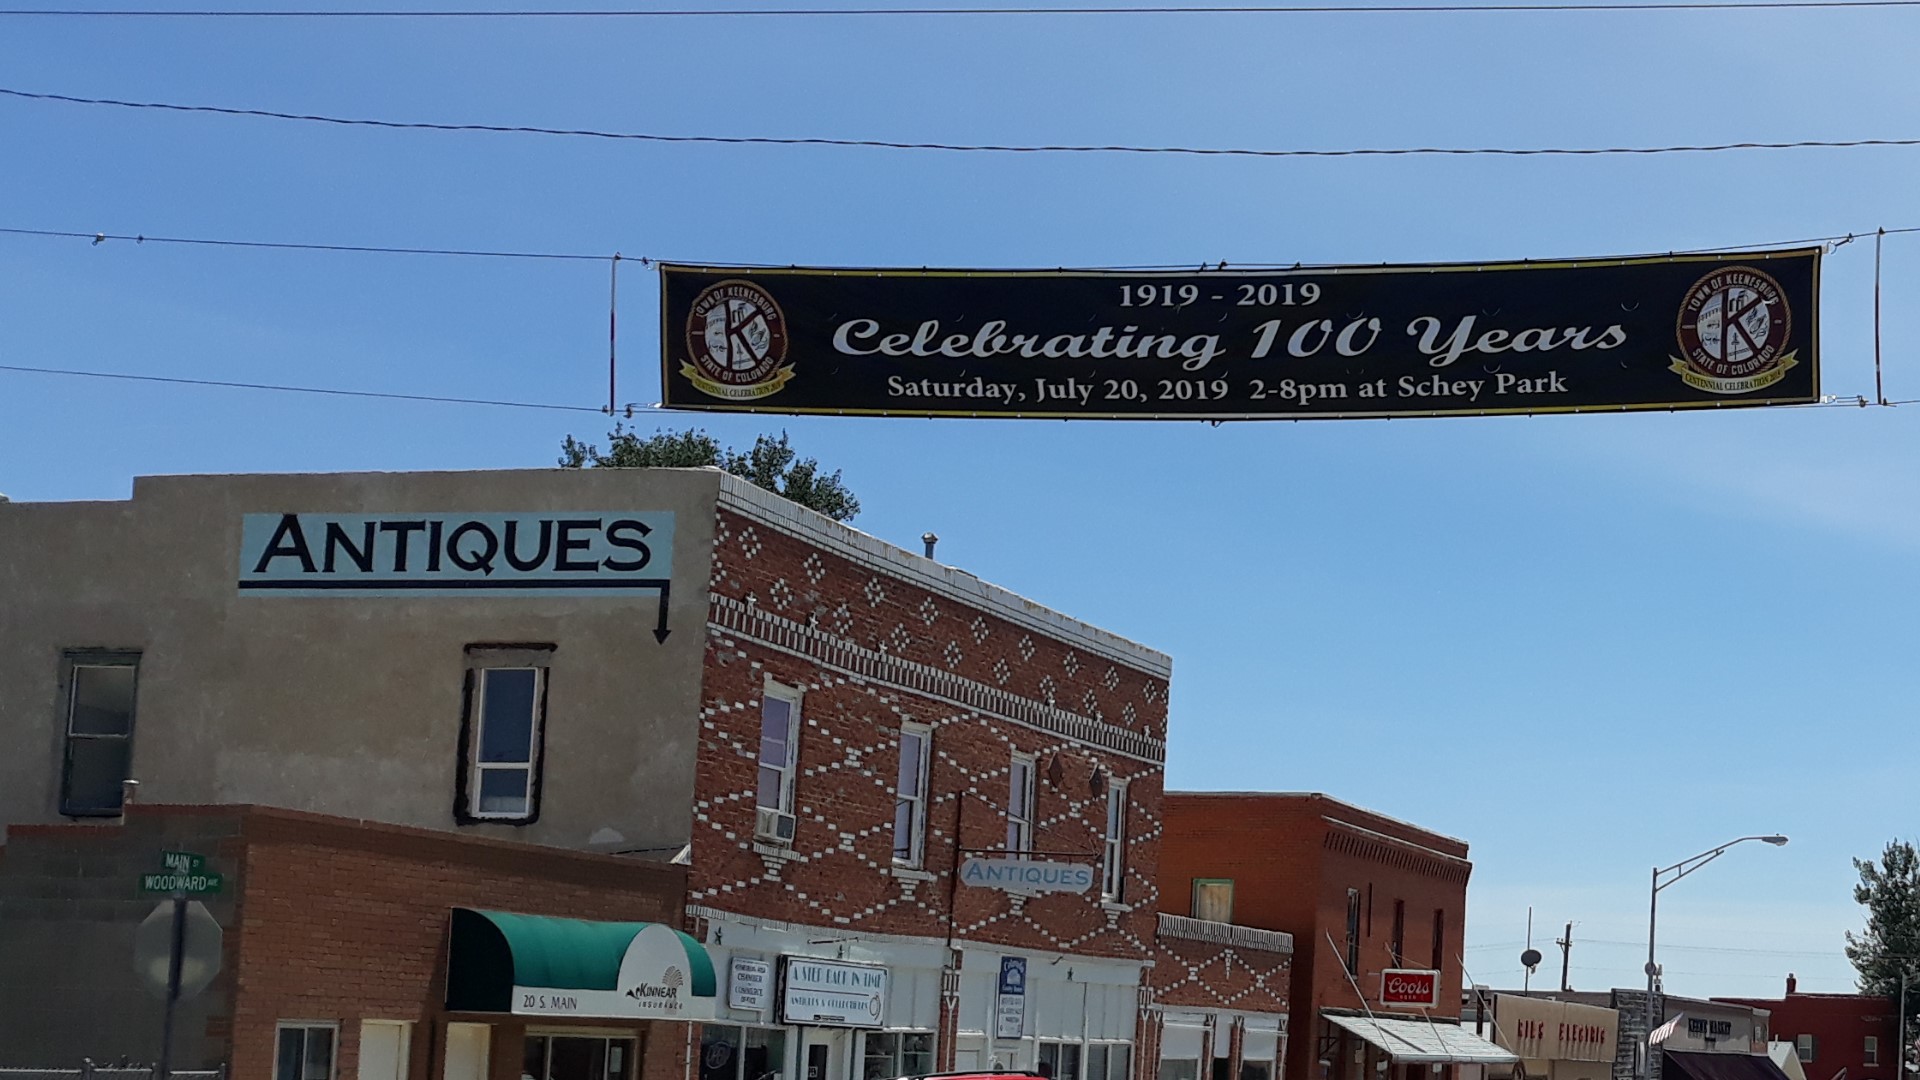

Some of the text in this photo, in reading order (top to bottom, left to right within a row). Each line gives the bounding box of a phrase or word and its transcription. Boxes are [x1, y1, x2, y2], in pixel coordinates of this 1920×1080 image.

[713, 289, 725, 299] OF
[1119, 284, 1199, 307] 1919
[1236, 282, 1321, 306] 2019
[1687, 284, 1712, 312] TOWN
[1711, 277, 1723, 289] OF
[833, 315, 1627, 371] Celebrating 100 Years
[700, 354, 774, 383] STATE OF COLORADO
[1692, 345, 1775, 376] STATE OF COLORADO
[887, 370, 1569, 406] Saturday, July 20, 2019 2-8pm at Schey Park
[252, 513, 654, 577] ANTIQUES
[165, 853, 190, 871] MAIN
[966, 862, 1089, 885] ANTIQUES
[145, 875, 207, 891] WOODWARD
[802, 965, 823, 983] STEP
[851, 970, 860, 986] IN
[864, 972, 882, 989] TIME
[1387, 977, 1430, 995] Coors
[523, 994, 535, 1008] 20
[551, 996, 577, 1010] MAIN
[638, 1000, 683, 1010] INSURANCE
